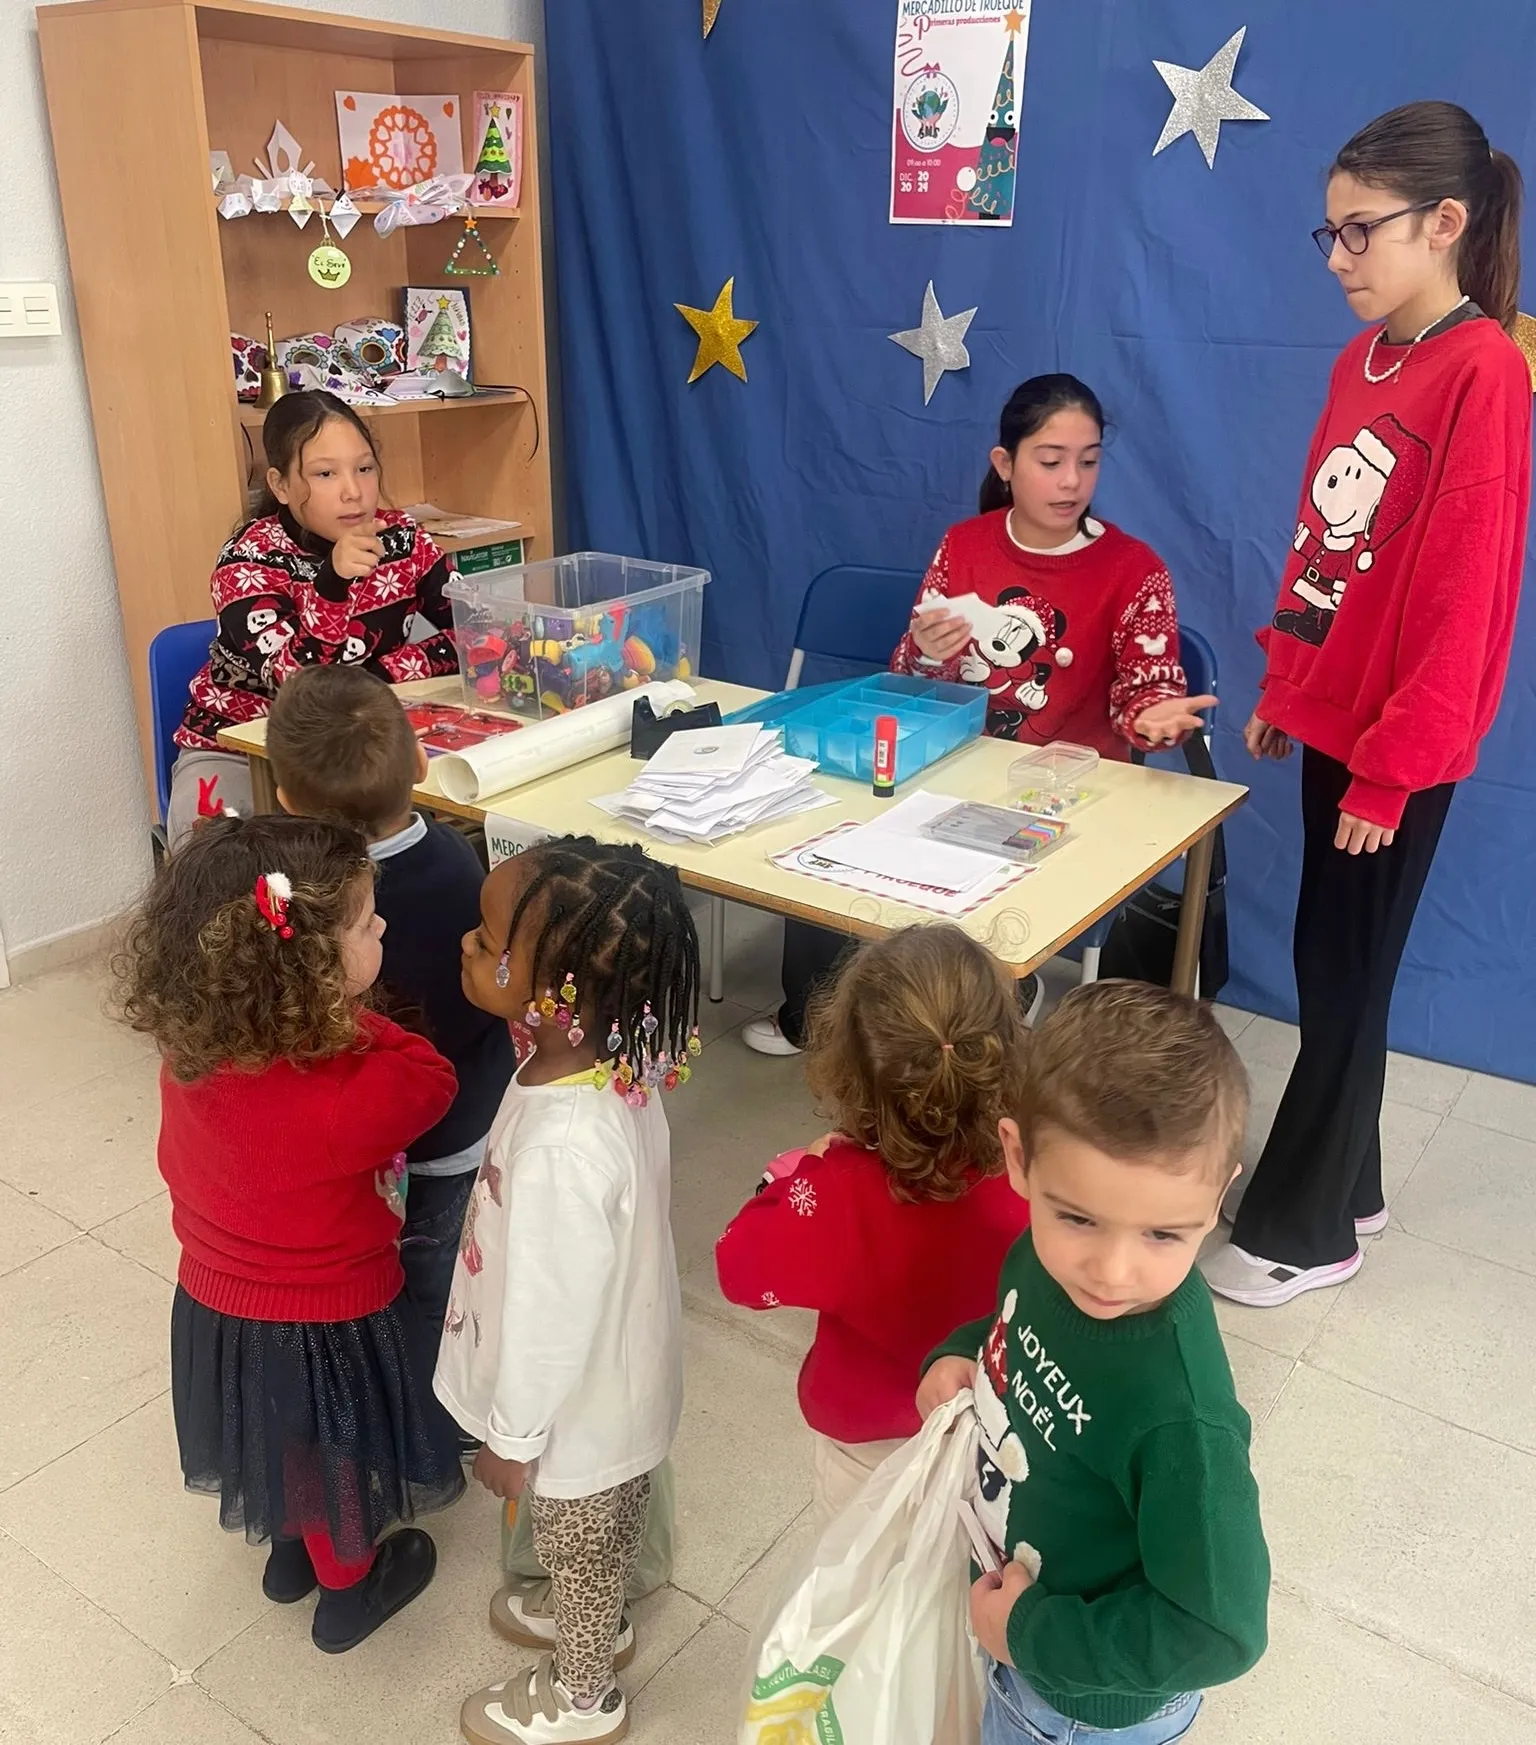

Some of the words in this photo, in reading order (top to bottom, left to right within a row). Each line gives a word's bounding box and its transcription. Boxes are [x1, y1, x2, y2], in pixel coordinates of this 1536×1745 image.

[902, 0, 963, 16] MERCADILLO
[964, 0, 976, 12] DE
[913, 14, 955, 40] Primeras
[956, 16, 1000, 27] producciones
[917, 171, 930, 182] 20
[900, 182, 912, 193] 20
[491, 836, 525, 856] MERC
[1017, 1325, 1092, 1435] JOYEUX
[1011, 1369, 1056, 1451] NOËL
